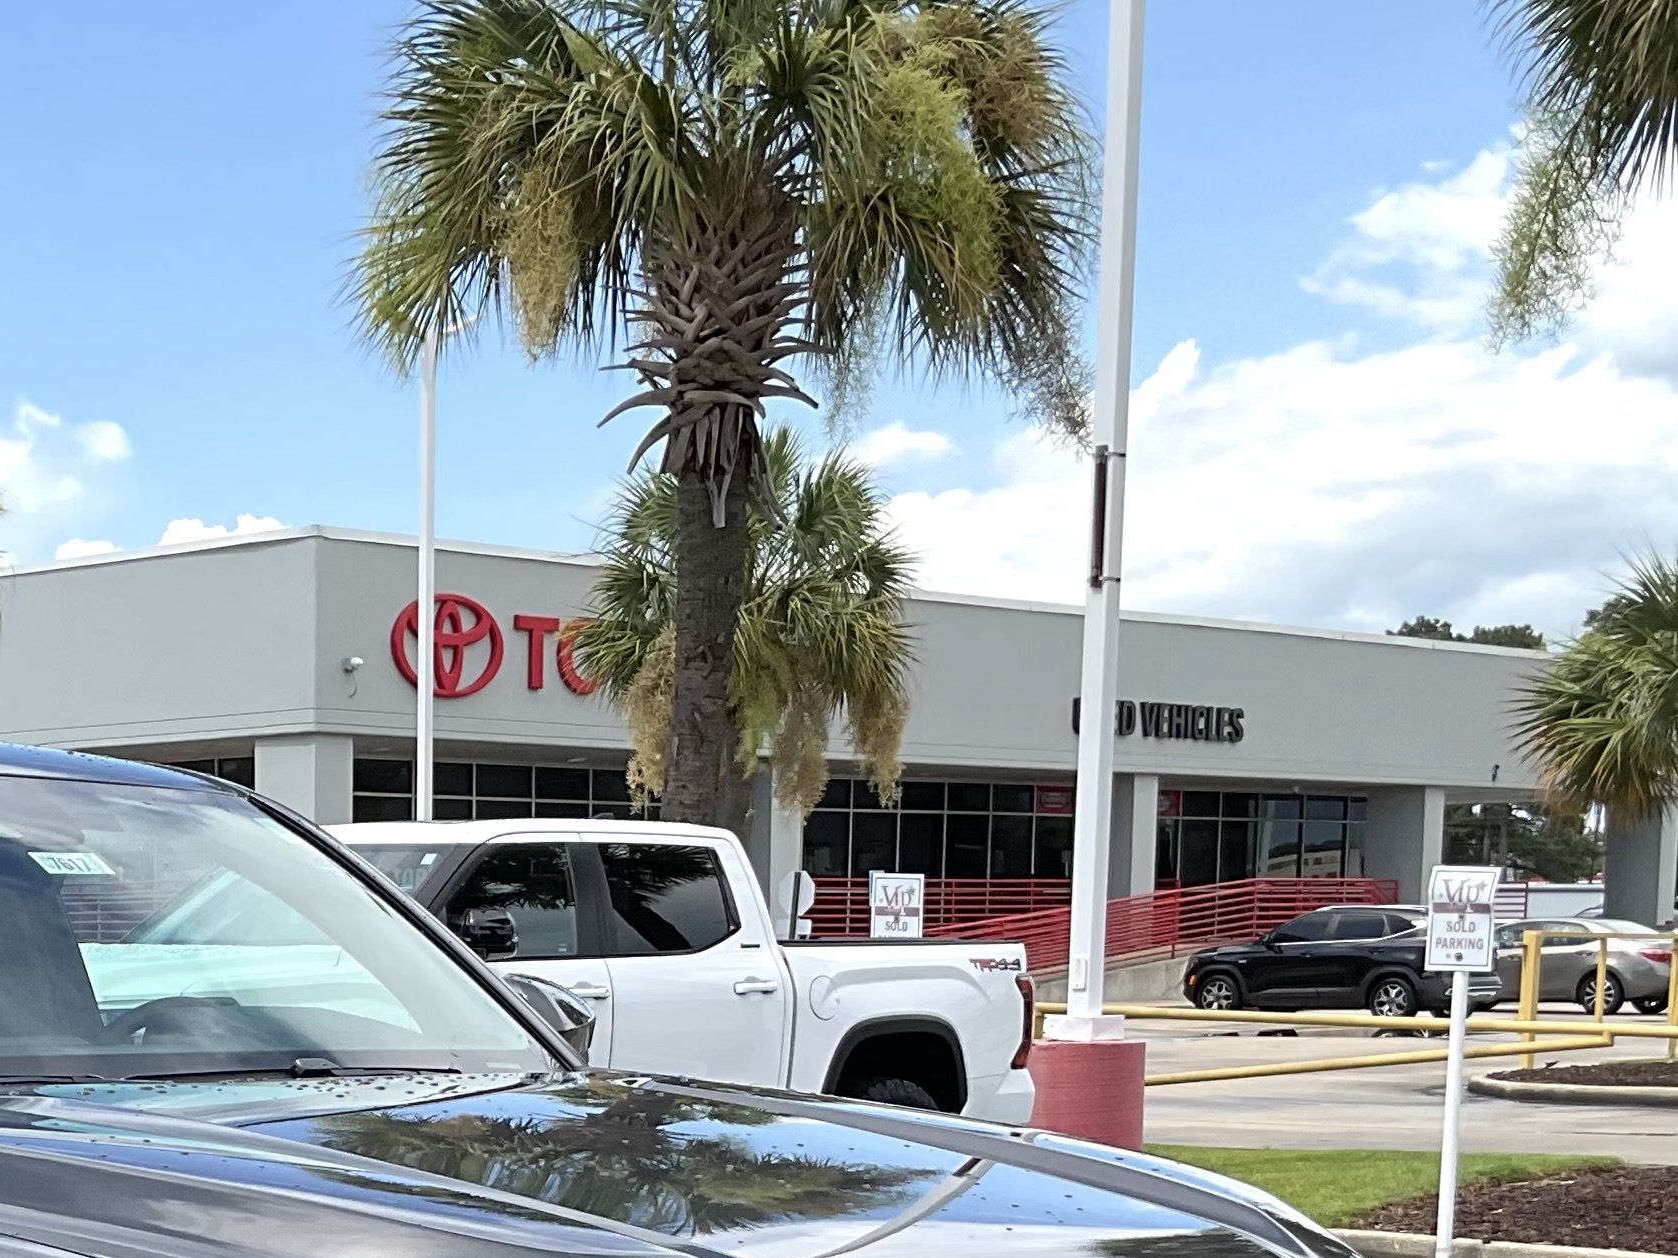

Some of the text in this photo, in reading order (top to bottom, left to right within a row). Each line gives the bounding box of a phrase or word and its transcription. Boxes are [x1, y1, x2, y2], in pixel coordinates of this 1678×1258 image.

[1139, 702, 1245, 742] VEHICLES
[885, 920, 908, 931] SOLD
[1447, 921, 1476, 933] SOLD
[1435, 937, 1484, 950] PARKING
